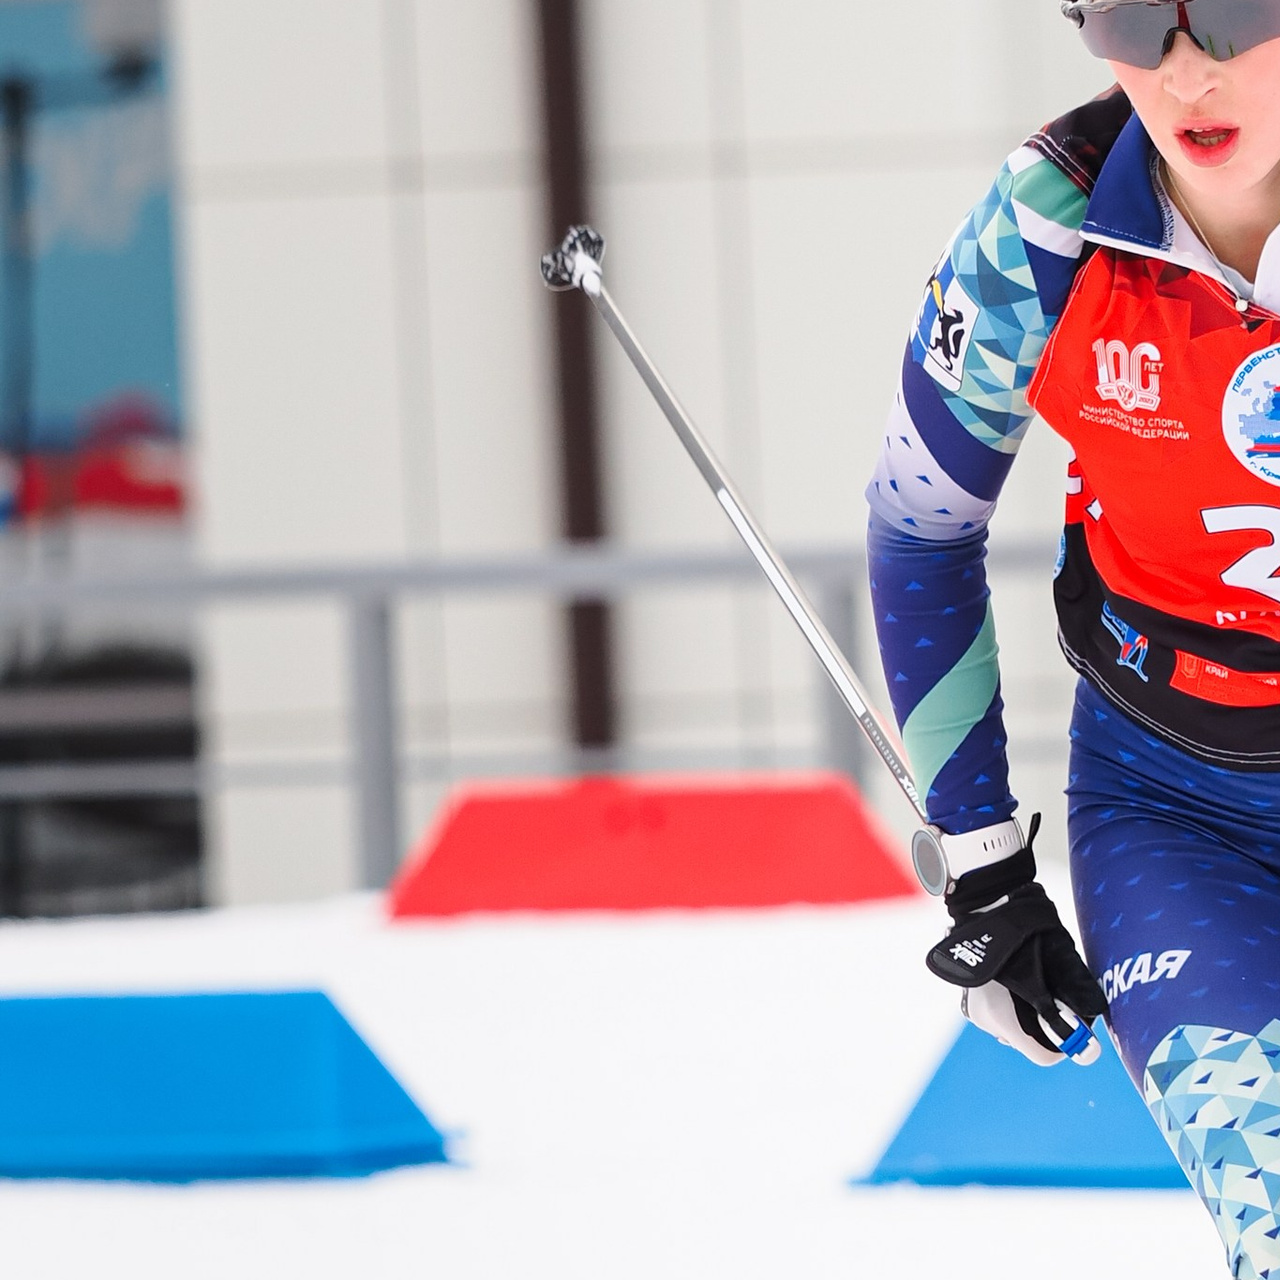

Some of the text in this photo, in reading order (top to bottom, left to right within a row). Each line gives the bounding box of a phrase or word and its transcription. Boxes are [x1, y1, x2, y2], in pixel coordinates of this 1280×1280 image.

[1144, 362, 1164, 373] ЛЕТ
[1083, 403, 1184, 430] МИНИСТЕРСТВО СПОРТА
[1131, 425, 1190, 440] ФЕДЕРАЦИИ
[1097, 949, 1193, 1005] СКАЯ
